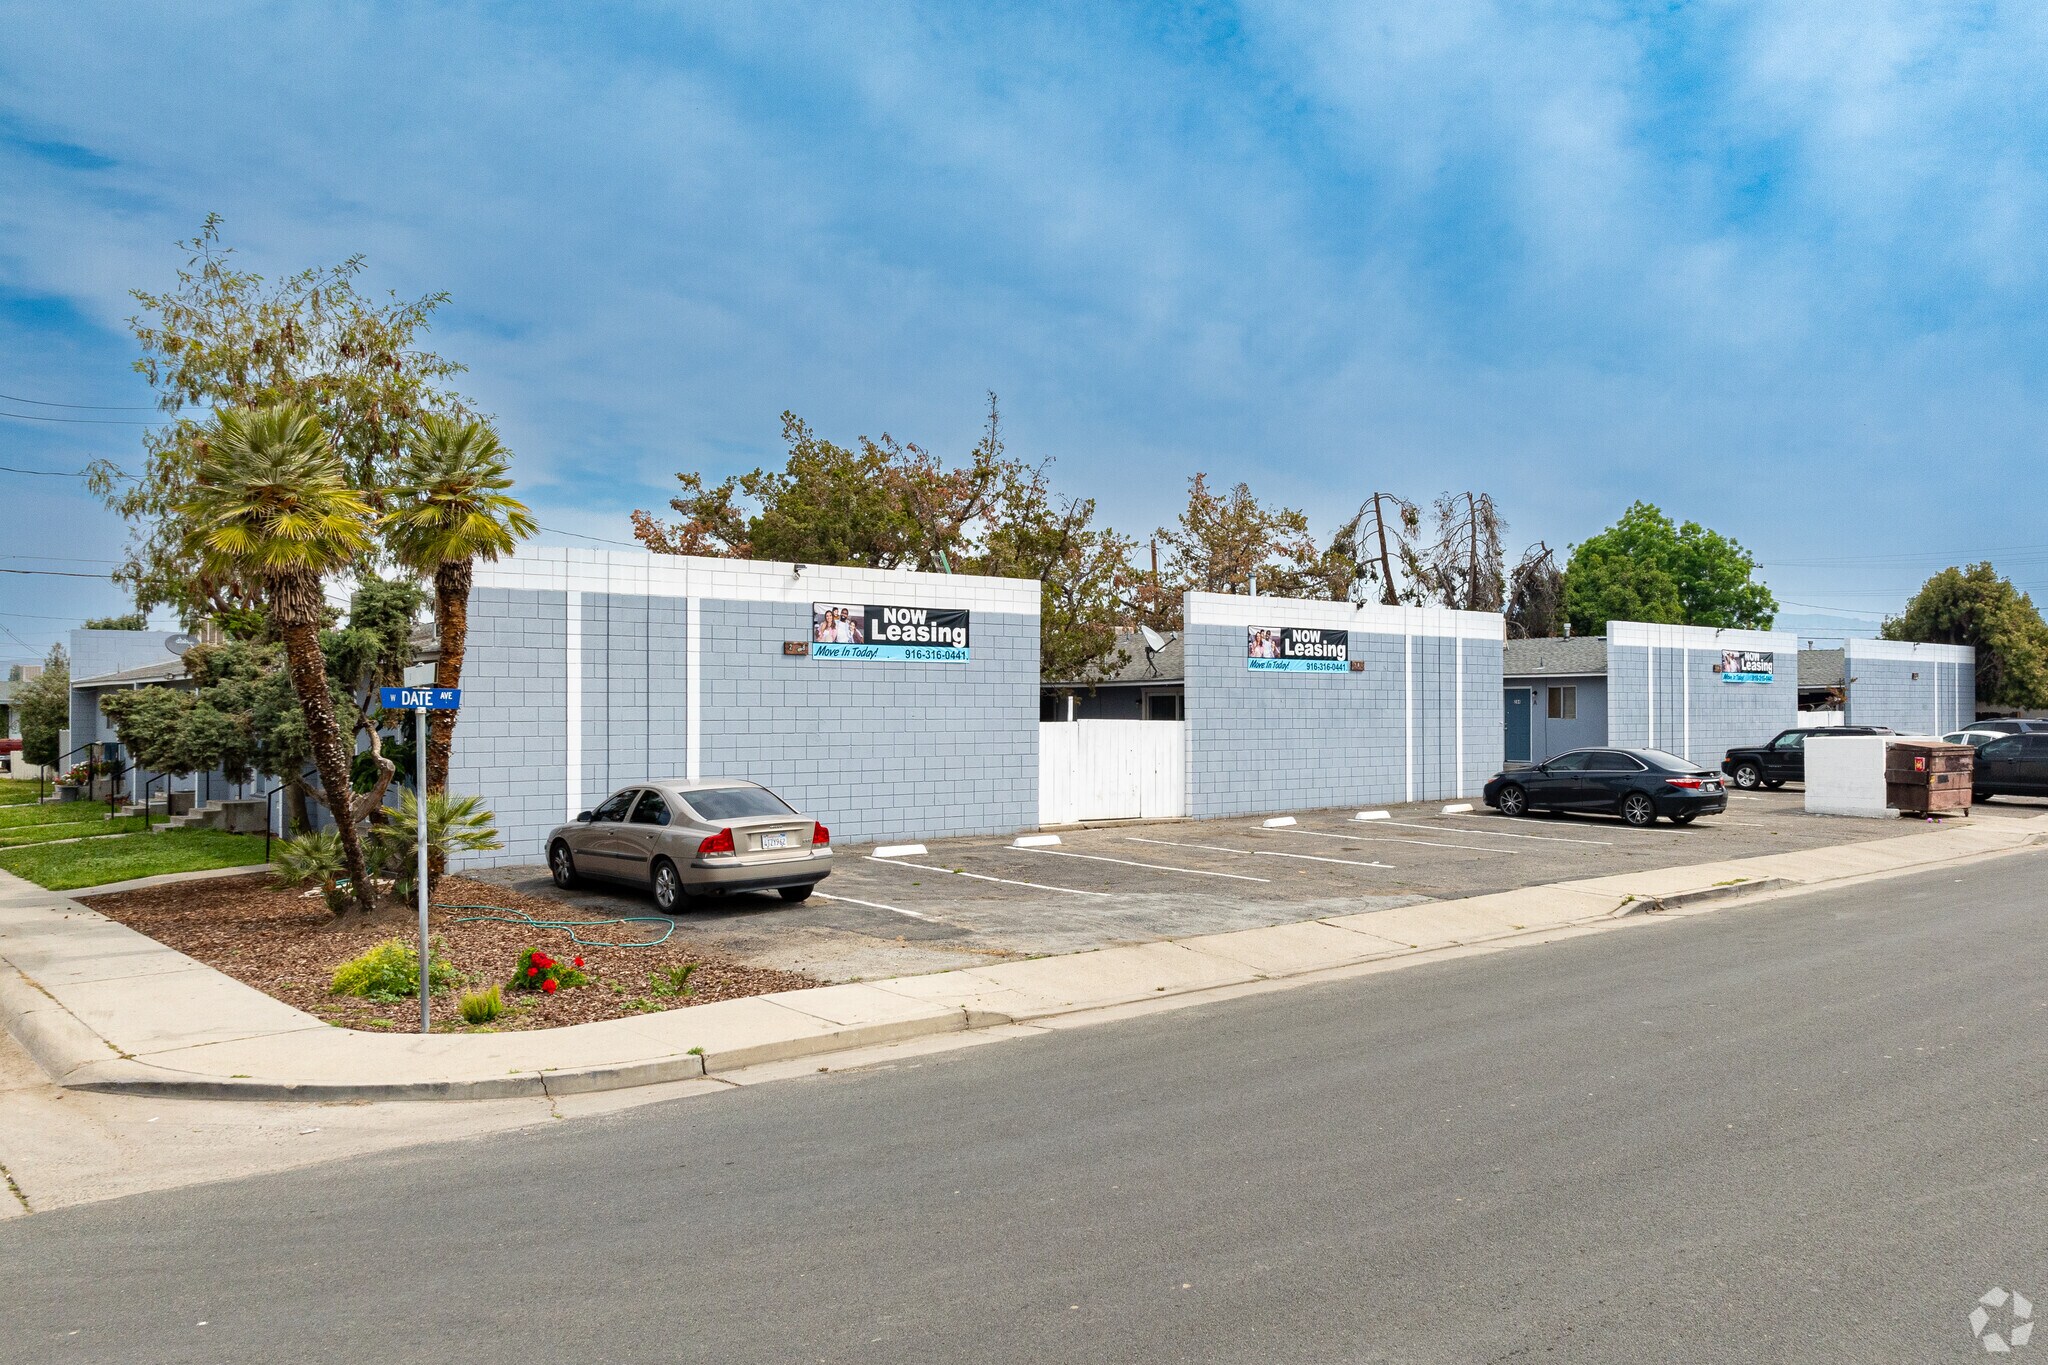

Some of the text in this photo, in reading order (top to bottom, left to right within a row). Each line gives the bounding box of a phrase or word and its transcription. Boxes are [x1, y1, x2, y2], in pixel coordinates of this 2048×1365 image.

[884, 608, 927, 625] NOW
[871, 619, 966, 648] Leasing
[1292, 630, 1321, 642] NOW
[814, 645, 839, 657] Move
[841, 646, 851, 657] In
[851, 647, 879, 660] Today!
[905, 649, 967, 660] 916-316-0441
[1284, 638, 1346, 661] Leasing
[1744, 652, 1760, 661] NOW
[1249, 659, 1265, 669] Move
[1306, 662, 1346, 671] 916-316-0441
[1741, 658, 1772, 674] Leasing
[390, 694, 396, 702] W
[401, 690, 433, 706] DATE
